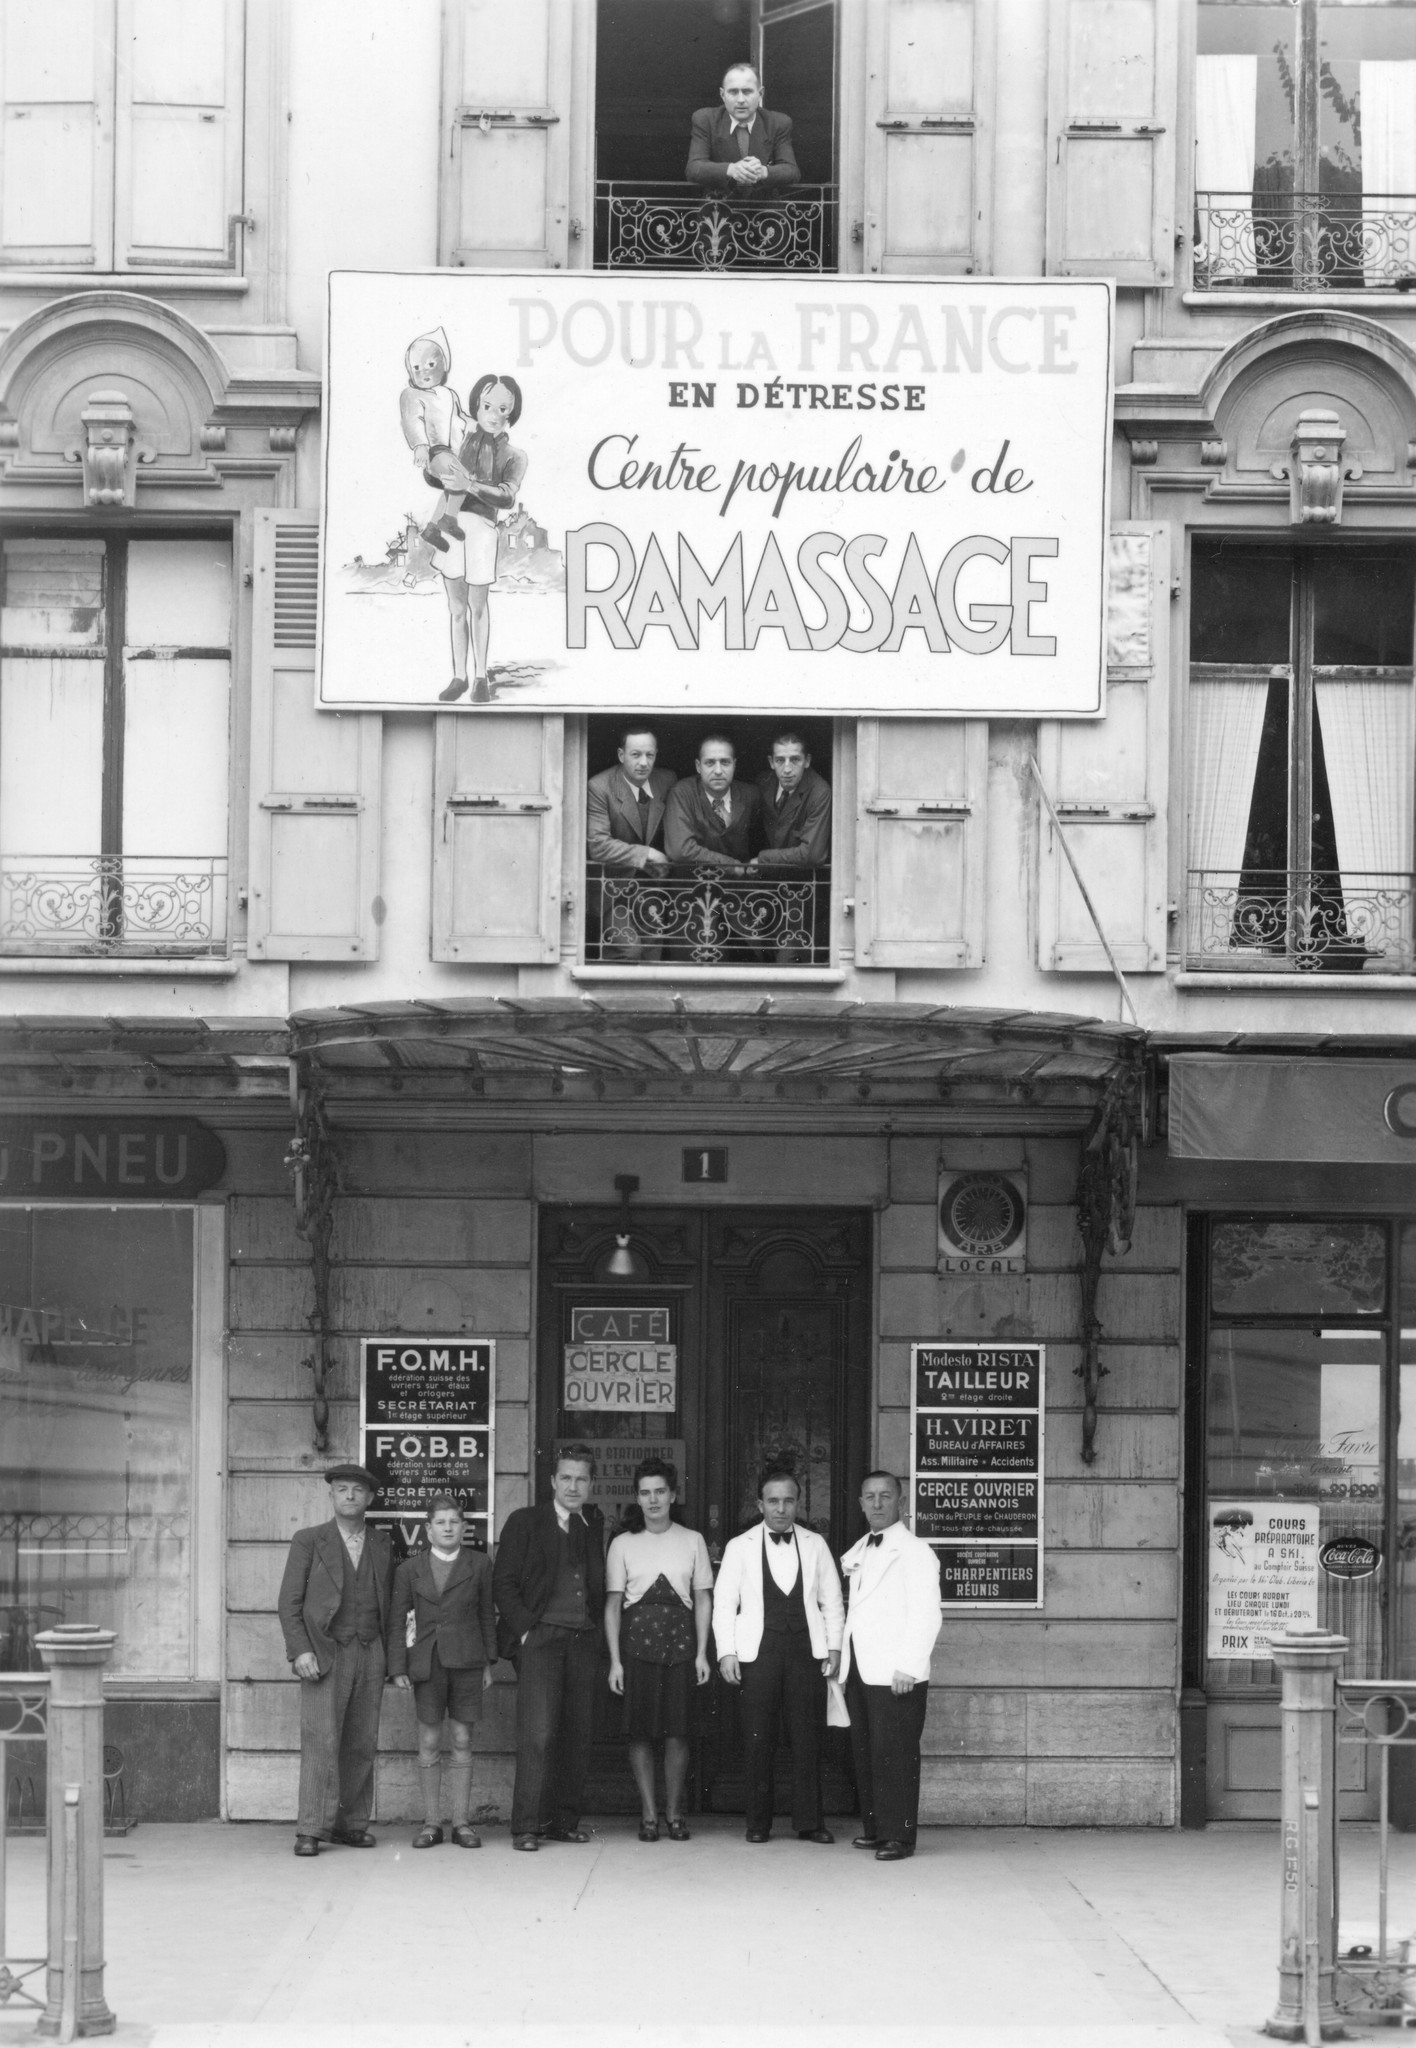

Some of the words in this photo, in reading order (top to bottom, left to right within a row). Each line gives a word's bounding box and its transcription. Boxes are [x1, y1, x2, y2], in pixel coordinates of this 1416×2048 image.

[508, 297, 704, 370] POUR
[718, 329, 771, 371] LA
[795, 302, 1079, 374] FRANCE
[668, 381, 717, 409] EN
[735, 375, 927, 411] DÉTRESSE
[586, 434, 718, 494] Centre
[718, 433, 947, 518] populaire
[970, 439, 1035, 494] de
[565, 521, 1060, 656] RAMASSAGE
[32, 1132, 188, 1184] PNEU
[699, 1152, 711, 1178] 1
[946, 1259, 1017, 1273] LOCAL
[577, 1311, 664, 1337] CAFÉ
[377, 1349, 485, 1371] F.O.M.H.
[570, 1351, 671, 1373] CERCLE
[922, 1352, 972, 1367] Modesto
[976, 1352, 1035, 1367] RISTA
[428, 1374, 453, 1382] suisse
[456, 1374, 470, 1382] des
[925, 1371, 1030, 1389] TAILLEUR
[425, 1382, 439, 1390] sur
[566, 1377, 673, 1404] OUVRIER
[960, 1393, 984, 1402] étage
[988, 1393, 1013, 1401] droite
[377, 1399, 477, 1411] SECRÉTARIAT
[399, 1411, 423, 1421] étage
[426, 1412, 468, 1421] supérieur
[376, 1436, 485, 1458] F.O.B.B.
[929, 1439, 969, 1450] BUREAU
[971, 1439, 1026, 1450] d'AFFAIRES
[1328, 1429, 1378, 1456] Favre
[426, 1461, 452, 1469] suisse
[454, 1461, 469, 1469] des
[920, 1456, 940, 1466] Ass.
[941, 1456, 979, 1466] Militaire
[990, 1456, 1035, 1467] Accidents
[401, 1476, 412, 1484] du
[423, 1469, 437, 1477] sur
[376, 1486, 477, 1498] SECRÉTARIAT
[918, 1482, 969, 1497] CERCLE
[973, 1482, 1035, 1497] OUVRIER
[398, 1498, 422, 1508] étage
[935, 1498, 1019, 1509] LAUSANNOIS
[917, 1512, 944, 1521] MAISON
[945, 1512, 954, 1521] du
[954, 1512, 982, 1521] PEUPLE
[983, 1513, 992, 1521] de
[994, 1511, 1037, 1521] CHAUDERON
[1269, 1518, 1306, 1531] COURS
[1254, 1530, 1315, 1546] PRÉPARATOIRE
[1267, 1548, 1275, 1558] A
[1323, 1547, 1375, 1564] Coca-Cola
[1264, 1560, 1292, 1573] Comptoir
[1294, 1561, 1315, 1571] Suisse
[945, 1567, 1033, 1581] CHARPENTIERS
[956, 1581, 1000, 1596] RÉUNIS
[1227, 1591, 1238, 1599] LES
[1239, 1591, 1260, 1600] COURS
[1262, 1592, 1290, 1600] AURONT
[1227, 1600, 1242, 1608] LIEU
[1244, 1600, 1269, 1608] CHAQUE
[1271, 1601, 1290, 1609] LUNDI
[1214, 1608, 1221, 1616] ET
[1223, 1607, 1262, 1617] DÉBUTERONT
[1222, 1635, 1249, 1649] PRIX
